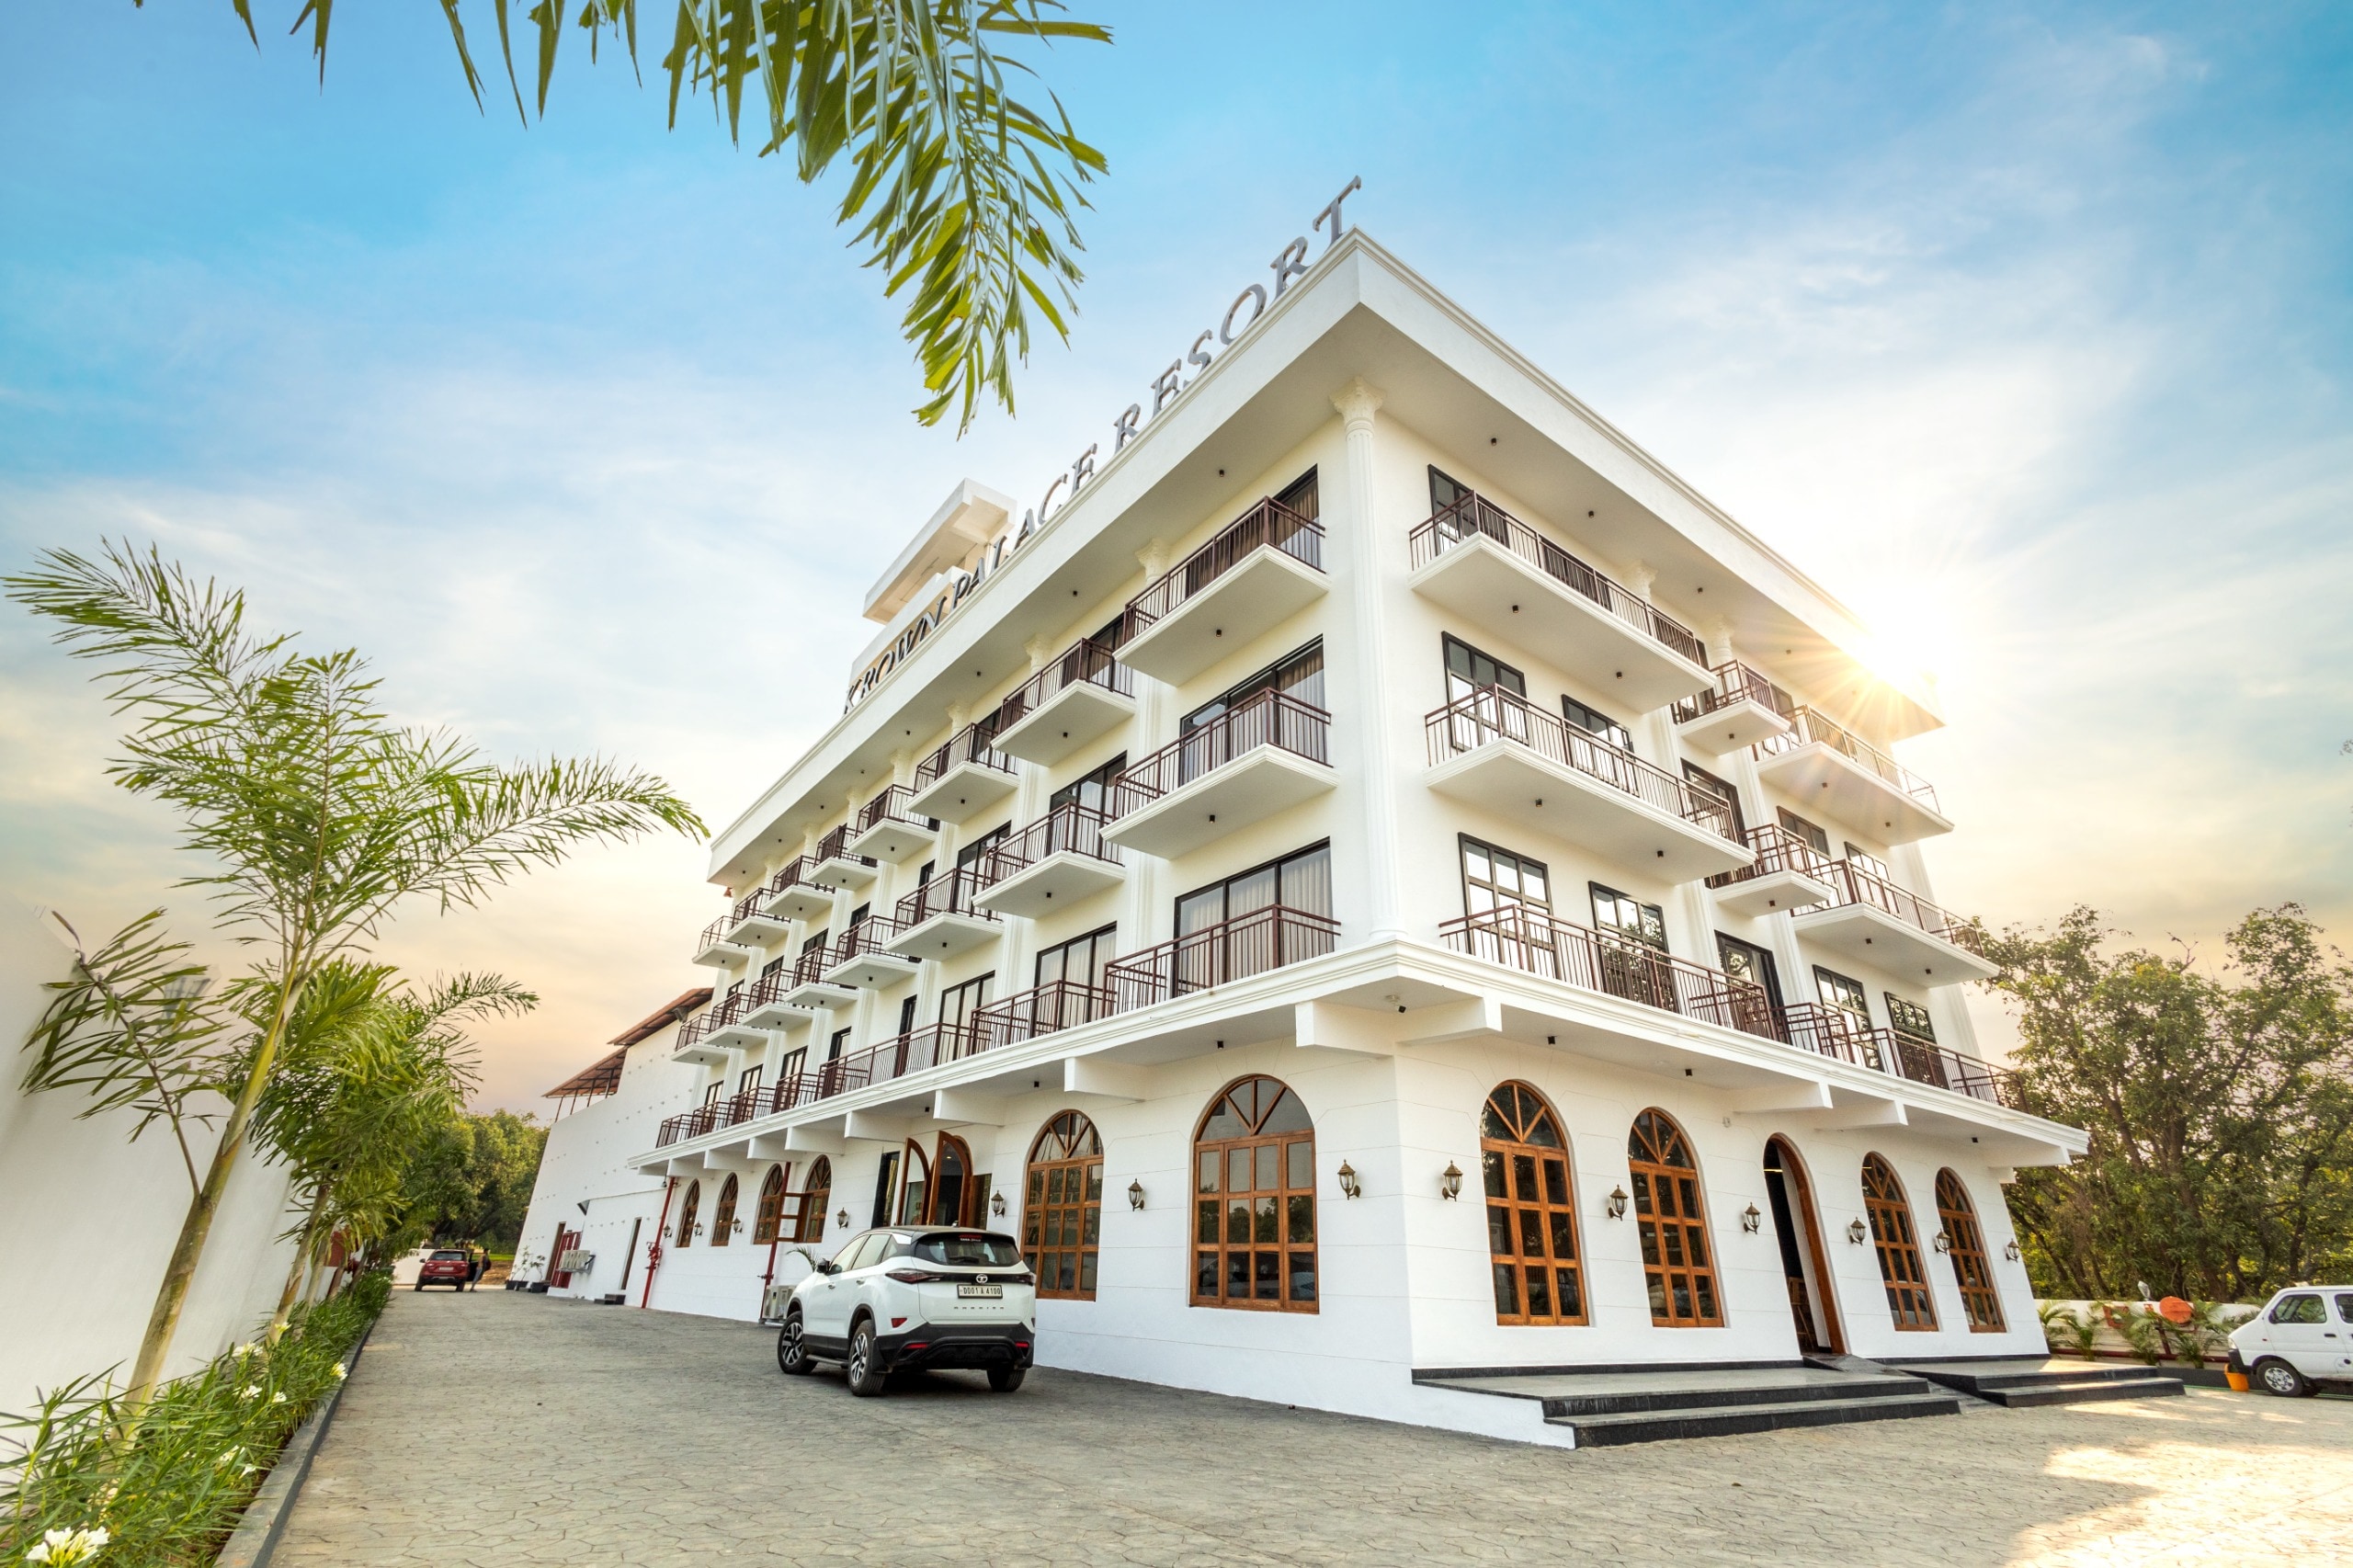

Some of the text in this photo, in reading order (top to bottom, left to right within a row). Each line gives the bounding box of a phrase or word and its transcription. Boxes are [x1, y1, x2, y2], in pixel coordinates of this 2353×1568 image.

[843, 175, 1362, 715] KROWN PALACE RESORT
